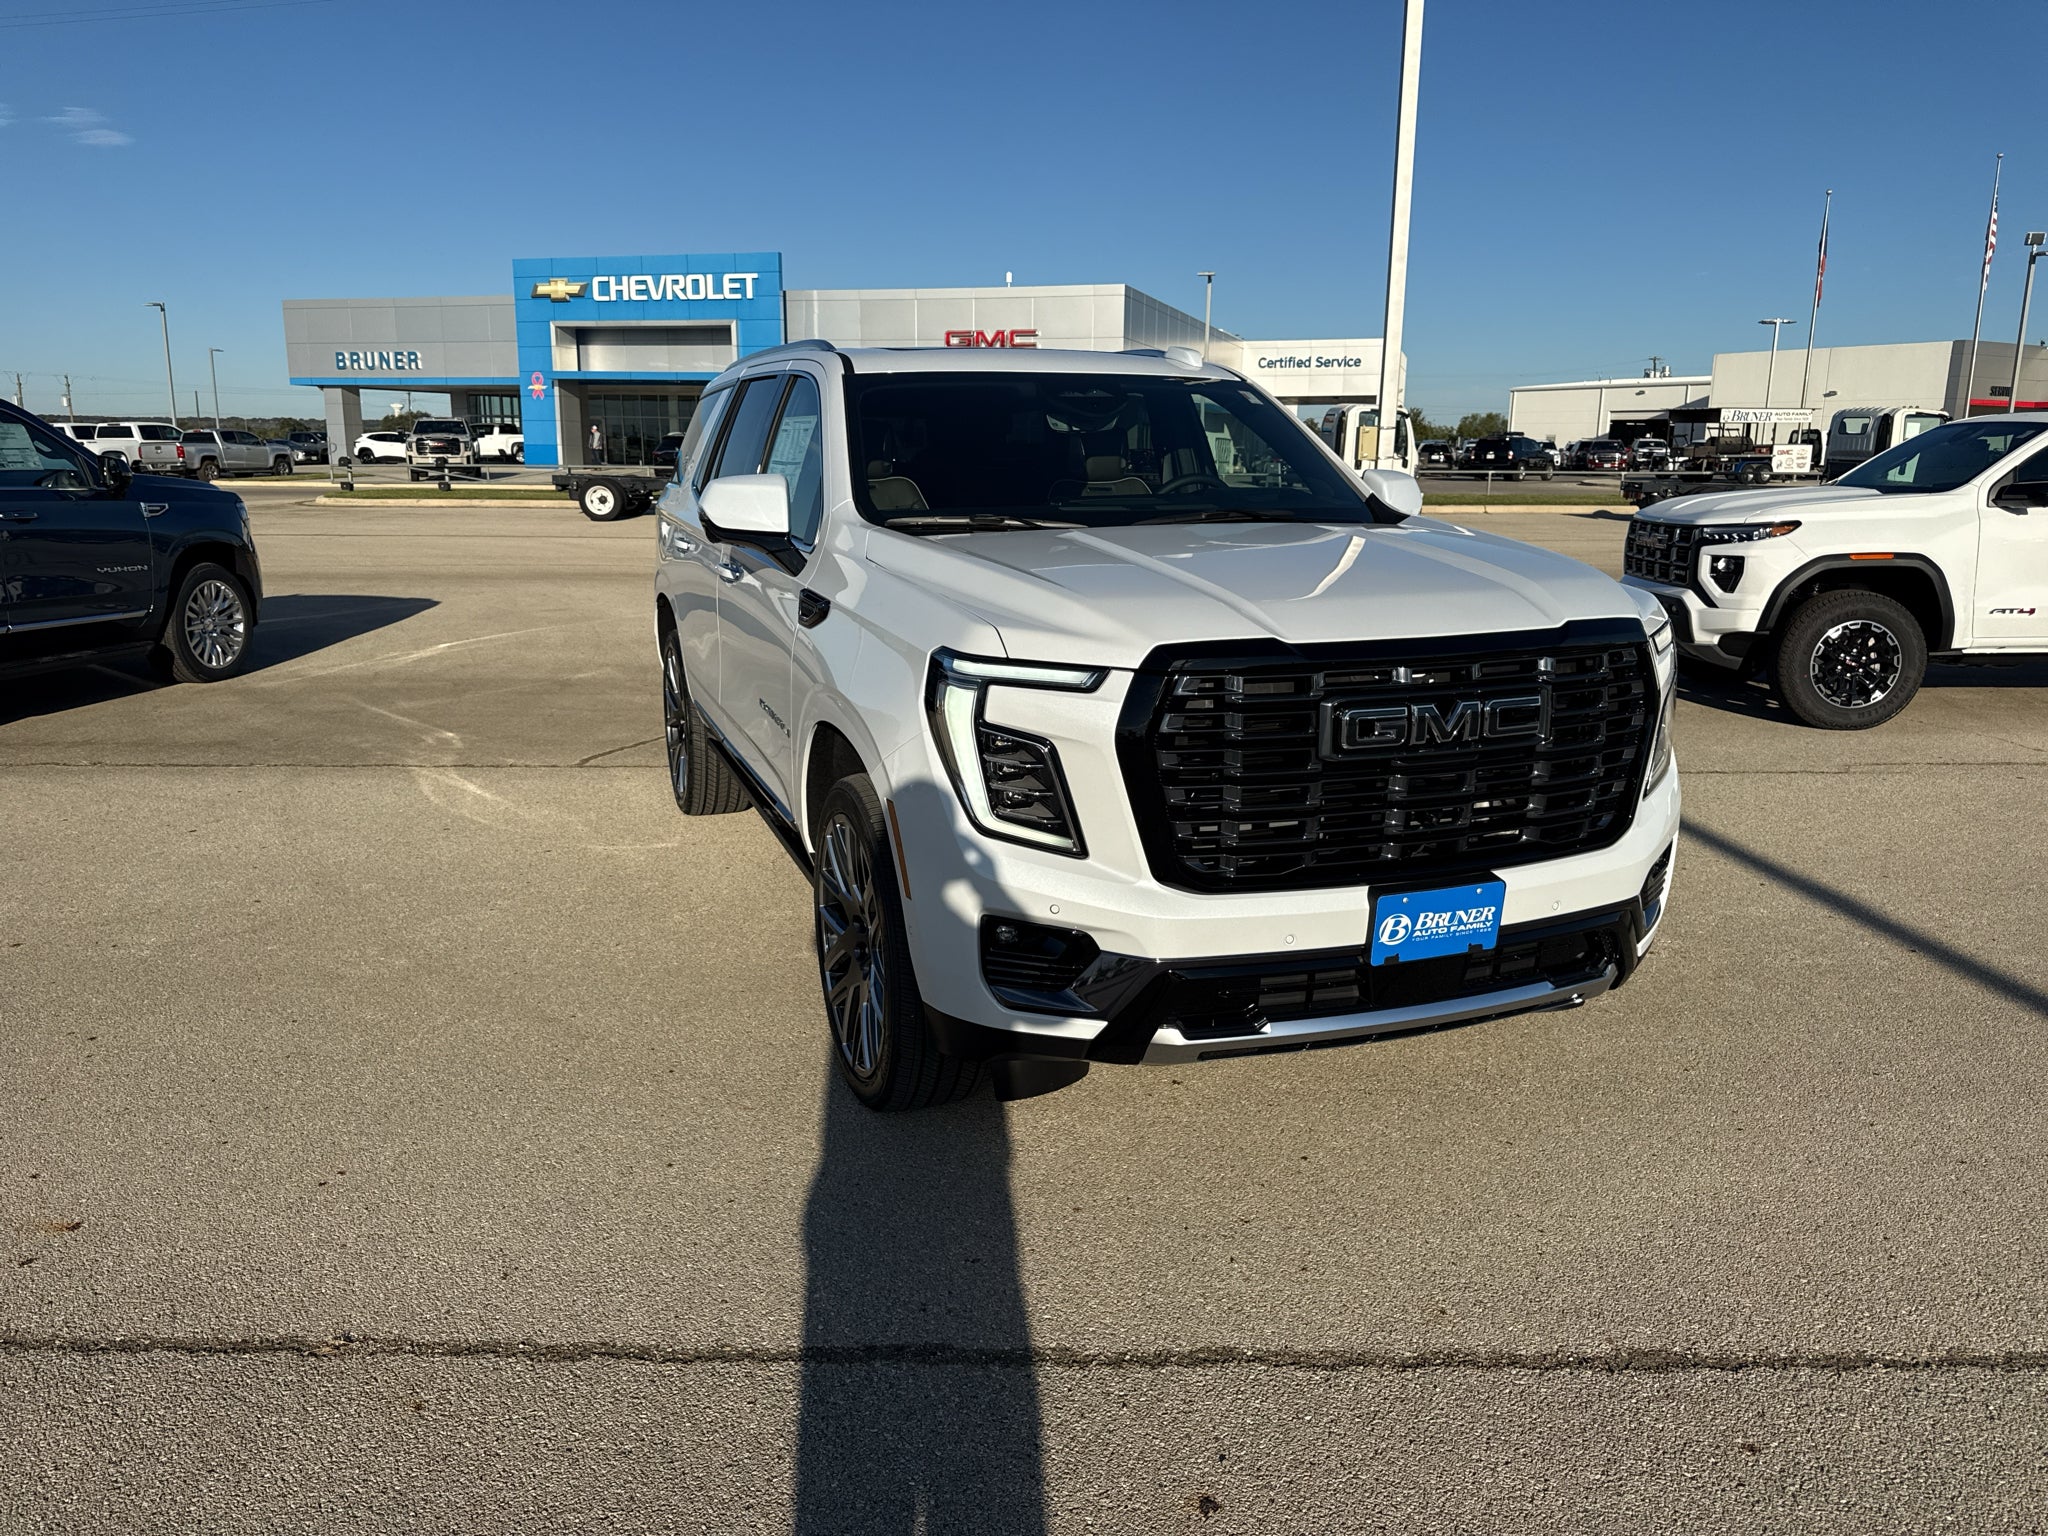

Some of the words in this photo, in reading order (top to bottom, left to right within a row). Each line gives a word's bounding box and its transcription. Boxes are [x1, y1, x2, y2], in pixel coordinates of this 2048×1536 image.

[592, 273, 758, 302] CHEVROLET
[945, 329, 1039, 348] GMC
[335, 351, 423, 371] BRUNER
[1258, 356, 1312, 368] Certified
[1315, 355, 1362, 368] Service
[1731, 409, 1773, 422] BRUNER
[96, 565, 149, 574] YUKON
[1988, 607, 2036, 617] AT4
[1341, 696, 1541, 750] GMC
[1413, 906, 1496, 931] BRUNER
[1412, 926, 1448, 937] AUTO
[1449, 920, 1494, 932] FAMILY
[1430, 932, 1454, 940] FAMILY
